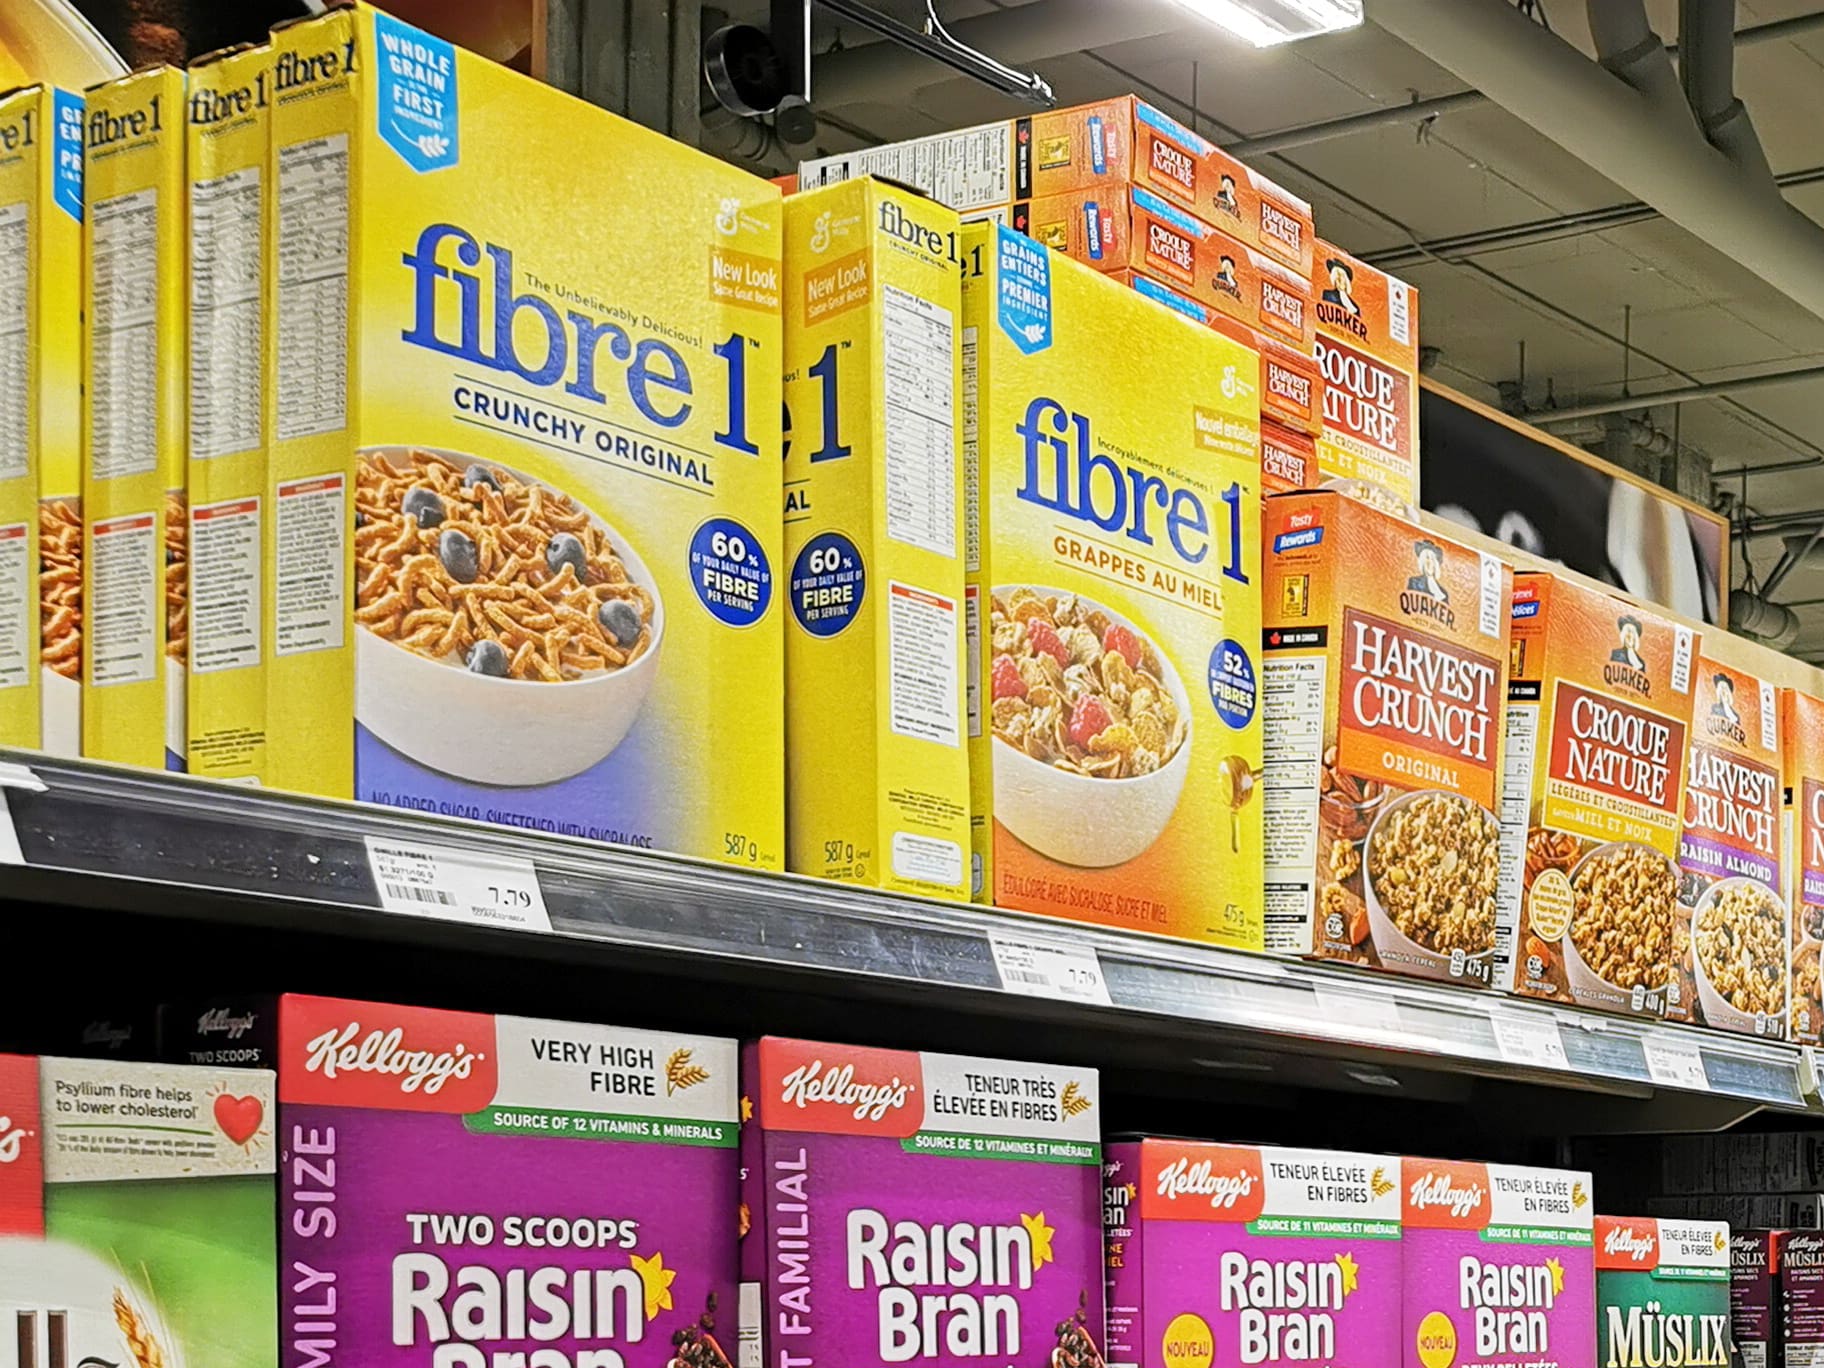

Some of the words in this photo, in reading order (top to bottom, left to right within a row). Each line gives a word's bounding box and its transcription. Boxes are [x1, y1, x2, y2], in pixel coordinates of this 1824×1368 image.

[380, 31, 452, 76] WHOLE
[389, 53, 448, 94] GRAIN
[391, 82, 446, 122] FIRST
[711, 255, 744, 284] New
[744, 264, 779, 291] Look
[1000, 252, 1049, 287] ENTIERS
[1002, 238, 1046, 271] GRAINS
[525, 272, 551, 292] The
[554, 282, 638, 329] Unbelievably
[641, 314, 705, 351] Delicious!
[1000, 280, 1050, 312] PREMIER
[401, 222, 695, 430] fibre
[454, 385, 586, 446] CRUNCHY
[595, 426, 715, 488] ORIGINAL
[1015, 397, 1209, 565] fibre
[712, 531, 745, 561] 60
[704, 571, 758, 600] FIBRE
[1053, 535, 1147, 581] GRAPPES
[1152, 567, 1178, 592] AU
[1181, 576, 1222, 611] MIEL
[707, 591, 722, 605] PER
[724, 596, 754, 612] SERVING
[1400, 590, 1455, 630] QUAKER
[1222, 652, 1243, 676] 52
[1352, 621, 1495, 711] HARVEST
[1212, 682, 1253, 711] FIBRES
[1353, 677, 1492, 763] CRUNCH
[1572, 695, 1670, 763] CROQUE
[1382, 751, 1460, 789] ORIGINAL
[1567, 739, 1668, 805] NATURE
[1576, 807, 1605, 830] MIEL
[1608, 815, 1620, 833] ET
[1622, 817, 1652, 840] NOIX
[724, 832, 747, 857] 587
[748, 843, 757, 862] g
[1680, 840, 1721, 871] RAISIN
[1725, 851, 1773, 882] ALMOND
[488, 887, 531, 909] 7.79
[305, 1021, 477, 1093] Kellogg's
[531, 1038, 593, 1065] VERY
[600, 1044, 654, 1069] HIGH
[55, 1080, 116, 1104] Psyllium
[119, 1083, 152, 1103] fibre
[156, 1086, 194, 1105] helps
[591, 1072, 656, 1097] FIBRE
[965, 1074, 1021, 1096] TENEUR
[1025, 1072, 1057, 1100] TRÈS
[56, 1101, 70, 1116] to
[74, 1100, 114, 1117] lower
[933, 1091, 985, 1118] ÉLEVÉE
[990, 1098, 1008, 1119] EN
[1011, 1100, 1057, 1122] FIBRES
[494, 1113, 547, 1129] SOURCE
[552, 1117, 569, 1129] OF
[573, 1119, 587, 1131] 12
[589, 1119, 648, 1135] VITAMINS
[652, 1124, 660, 1136] &
[663, 1124, 722, 1140] MINERALS
[295, 1126, 336, 1239] SIZE
[406, 1214, 494, 1246] TWO
[504, 1217, 637, 1249] SCOOPS
[777, 1147, 813, 1338] FAMILIAL
[846, 1208, 1033, 1291] Raisin
[391, 1251, 645, 1346] Raisin
[877, 1290, 1022, 1362] Bran
[1166, 1338, 1212, 1360] NOUVEAU
